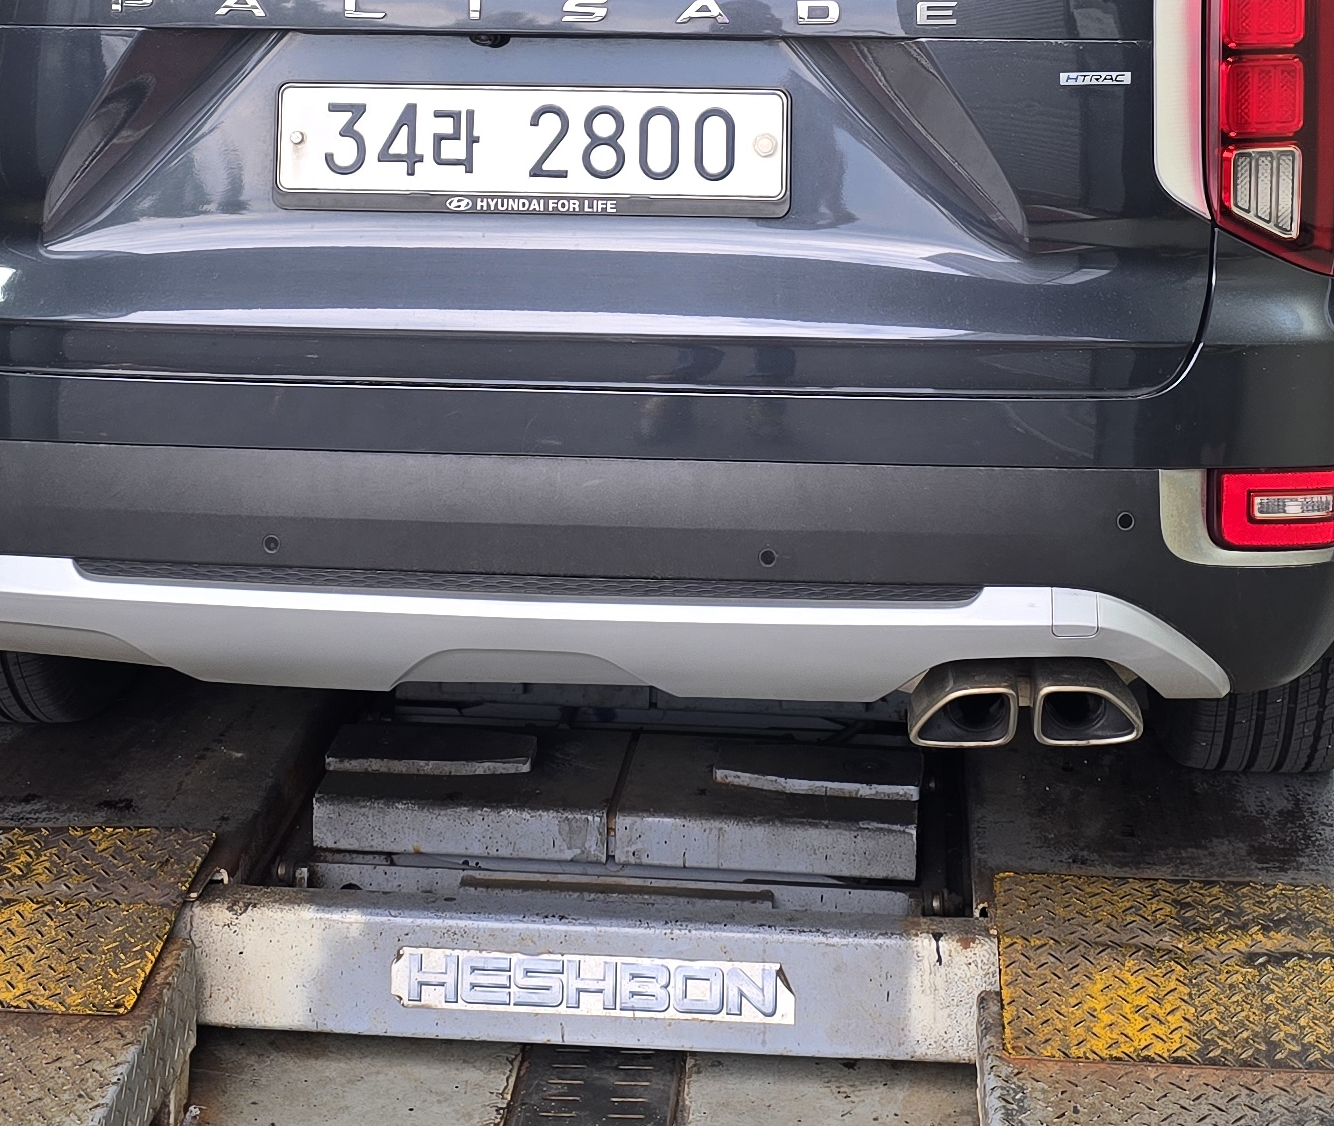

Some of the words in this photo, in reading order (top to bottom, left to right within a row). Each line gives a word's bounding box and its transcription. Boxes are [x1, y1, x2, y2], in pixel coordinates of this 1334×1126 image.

[1066, 74, 1125, 83] HTRAC
[324, 103, 480, 176] 34라
[529, 104, 736, 182] 2800
[476, 198, 544, 211] HYUNDAI
[548, 199, 580, 212] FOR
[584, 200, 617, 213] LIFE
[408, 952, 778, 1018] HESHBON
